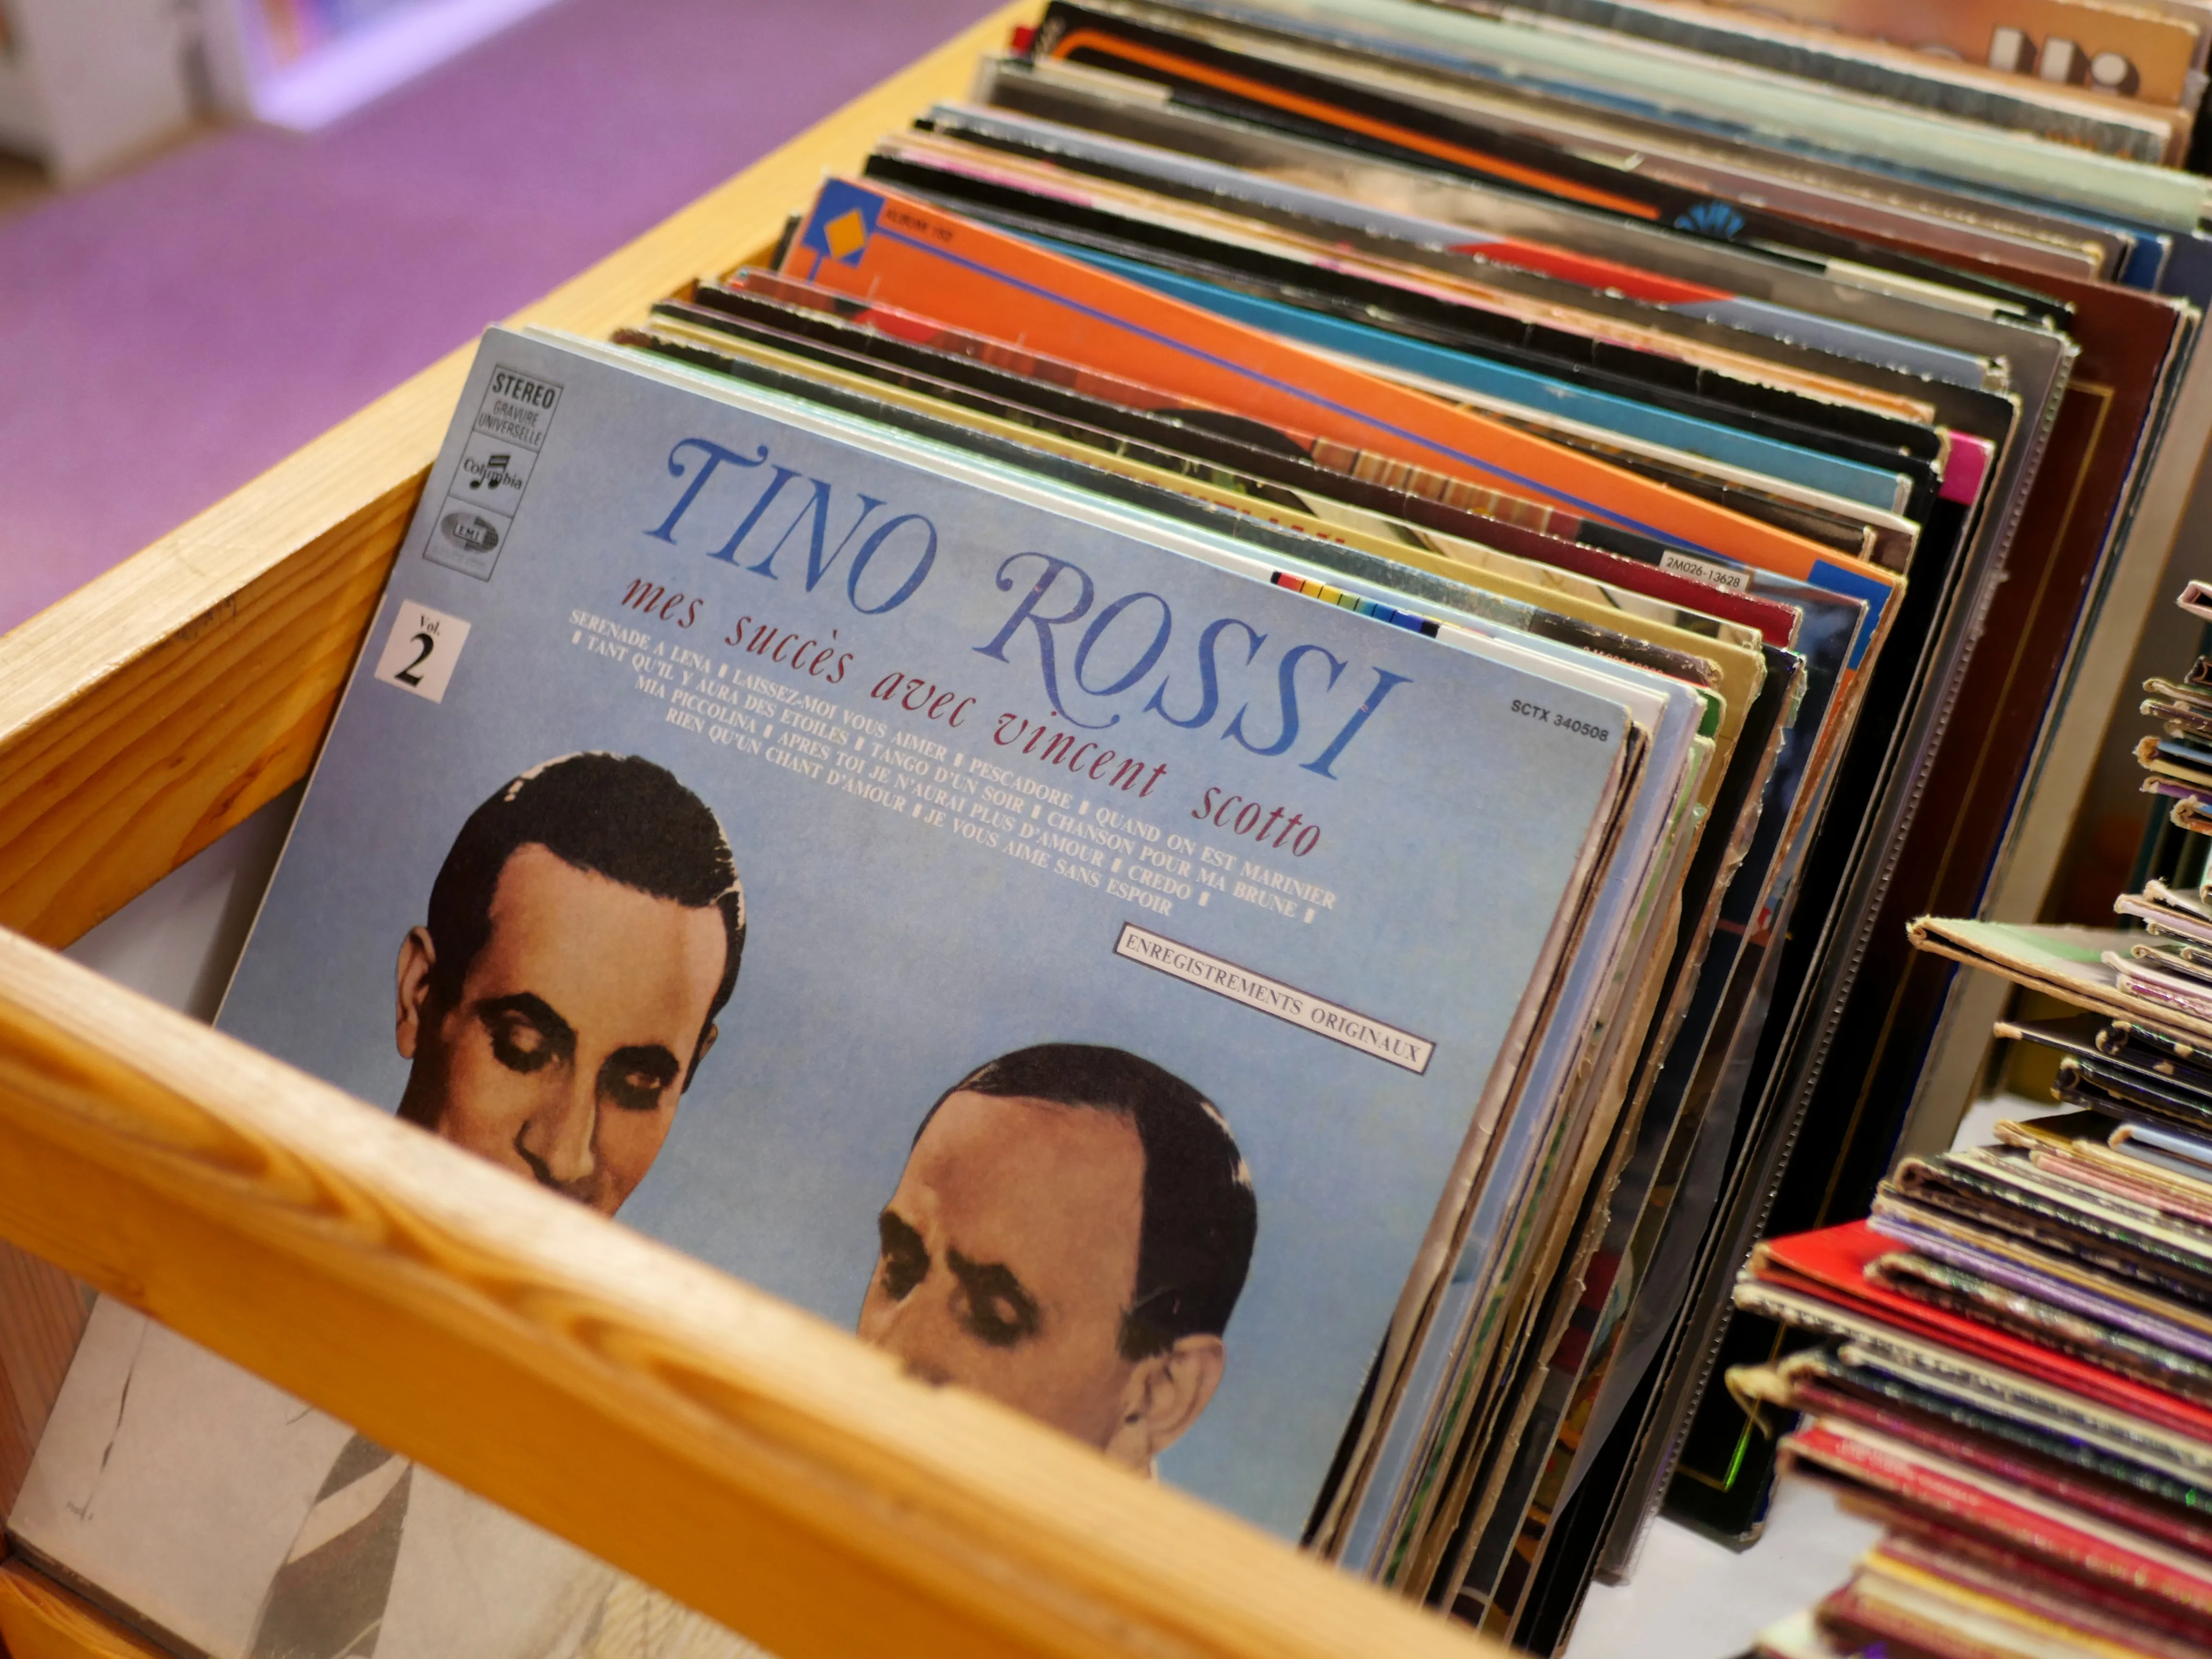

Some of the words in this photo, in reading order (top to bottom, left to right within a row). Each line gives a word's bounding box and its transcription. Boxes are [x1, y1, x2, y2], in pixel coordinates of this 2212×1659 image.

[493, 372, 555, 409] STEREO
[493, 401, 539, 428] GRAVURE
[478, 413, 542, 446] UNIVERSELLE
[463, 458, 522, 490] Columbia
[1666, 557, 1741, 588] 2M026-13628
[421, 614, 441, 637] Vol.
[645, 437, 937, 614] TINO
[973, 552, 1413, 779] ROSSI
[394, 632, 434, 688] 2
[622, 579, 703, 627] mes
[725, 616, 854, 683] succès
[871, 673, 976, 727] avec
[994, 711, 1166, 797] vincent
[1191, 787, 1320, 856] scotto
[1511, 699, 1551, 723] SCTX
[1553, 714, 1610, 743] 340508
[570, 610, 650, 650] SERENADE
[653, 641, 665, 656] A
[671, 646, 710, 673] LENA
[733, 670, 838, 719] LAISSEZ-MOI
[844, 710, 887, 738] VOUS
[891, 732, 947, 762] AIMER
[969, 758, 1073, 809] PESCADORE
[1096, 807, 1160, 842] QUAND
[1167, 835, 1196, 855] ON
[1201, 846, 1237, 871] EST
[1240, 862, 1336, 909] MARINIER
[588, 636, 628, 661] TANT
[632, 653, 673, 680] QU'IL
[682, 671, 693, 685] Y
[696, 678, 738, 705] AURA
[744, 695, 775, 717] DES
[780, 709, 847, 745] ETOILES
[871, 743, 929, 775] TANGO
[934, 767, 976, 794] D'UN
[982, 786, 1024, 813] SOIR
[1048, 812, 1133, 855] CHANSON
[1139, 846, 1191, 877] POUR
[1197, 868, 1225, 891] MA
[1232, 882, 1297, 917] BRUNE
[635, 675, 665, 698] MIA
[672, 689, 755, 733] PICCOLINA
[778, 732, 830, 760] APRES
[837, 751, 866, 773] TOI
[869, 766, 890, 783] JE
[894, 774, 966, 812] N'AURAI
[970, 803, 1013, 831] PLUS
[1019, 822, 1104, 867] D'AMOUR
[1129, 866, 1191, 899] CREDO
[666, 708, 705, 733] RIEN
[709, 725, 761, 754] QU'UN
[766, 747, 823, 779] CHANT
[826, 769, 906, 812] D'AMOUR
[924, 809, 946, 827] JE
[954, 818, 999, 847] VOUS
[1003, 841, 1050, 867] AIME
[1054, 859, 1101, 887] SANS
[1106, 878, 1172, 916] ESPOIR
[1126, 934, 1302, 1014] ENREGISTREMENTS
[1311, 1009, 1420, 1062] ORIGINAUX
